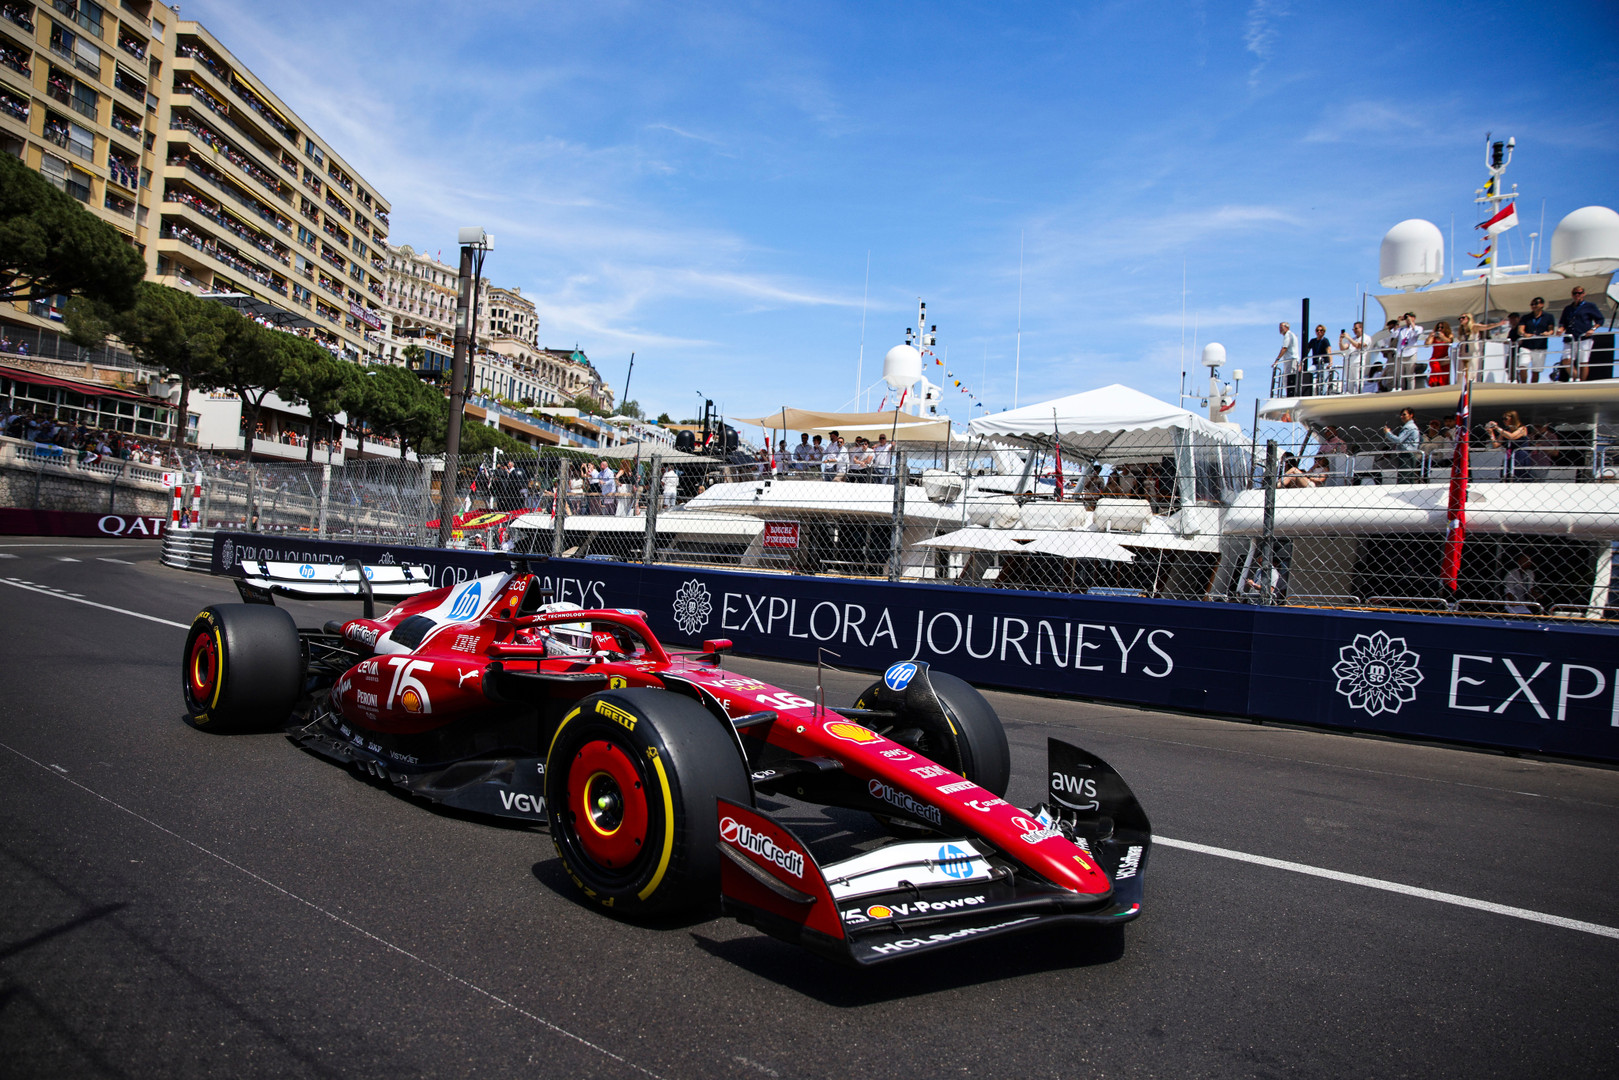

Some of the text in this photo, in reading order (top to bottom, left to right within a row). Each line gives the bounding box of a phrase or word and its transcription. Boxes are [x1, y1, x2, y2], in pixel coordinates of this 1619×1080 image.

[98, 515, 167, 536] QAT
[301, 565, 314, 579] hp
[452, 583, 481, 620] hp
[451, 634, 481, 653] IBM
[721, 592, 1175, 678] EXPLORA JOURNEYS
[357, 661, 379, 676] CEVA
[886, 664, 914, 690] hp
[698, 678, 765, 688] VGW
[357, 689, 378, 707] PERONI
[755, 692, 816, 710] 16
[595, 700, 638, 732] PIRELLI
[880, 749, 907, 757] aws
[910, 765, 951, 779] IBM
[1052, 771, 1098, 798] aws
[884, 784, 942, 825] UniCredit
[737, 823, 804, 879] UniCredit
[941, 845, 973, 879] hp
[890, 895, 986, 915] V-Power
